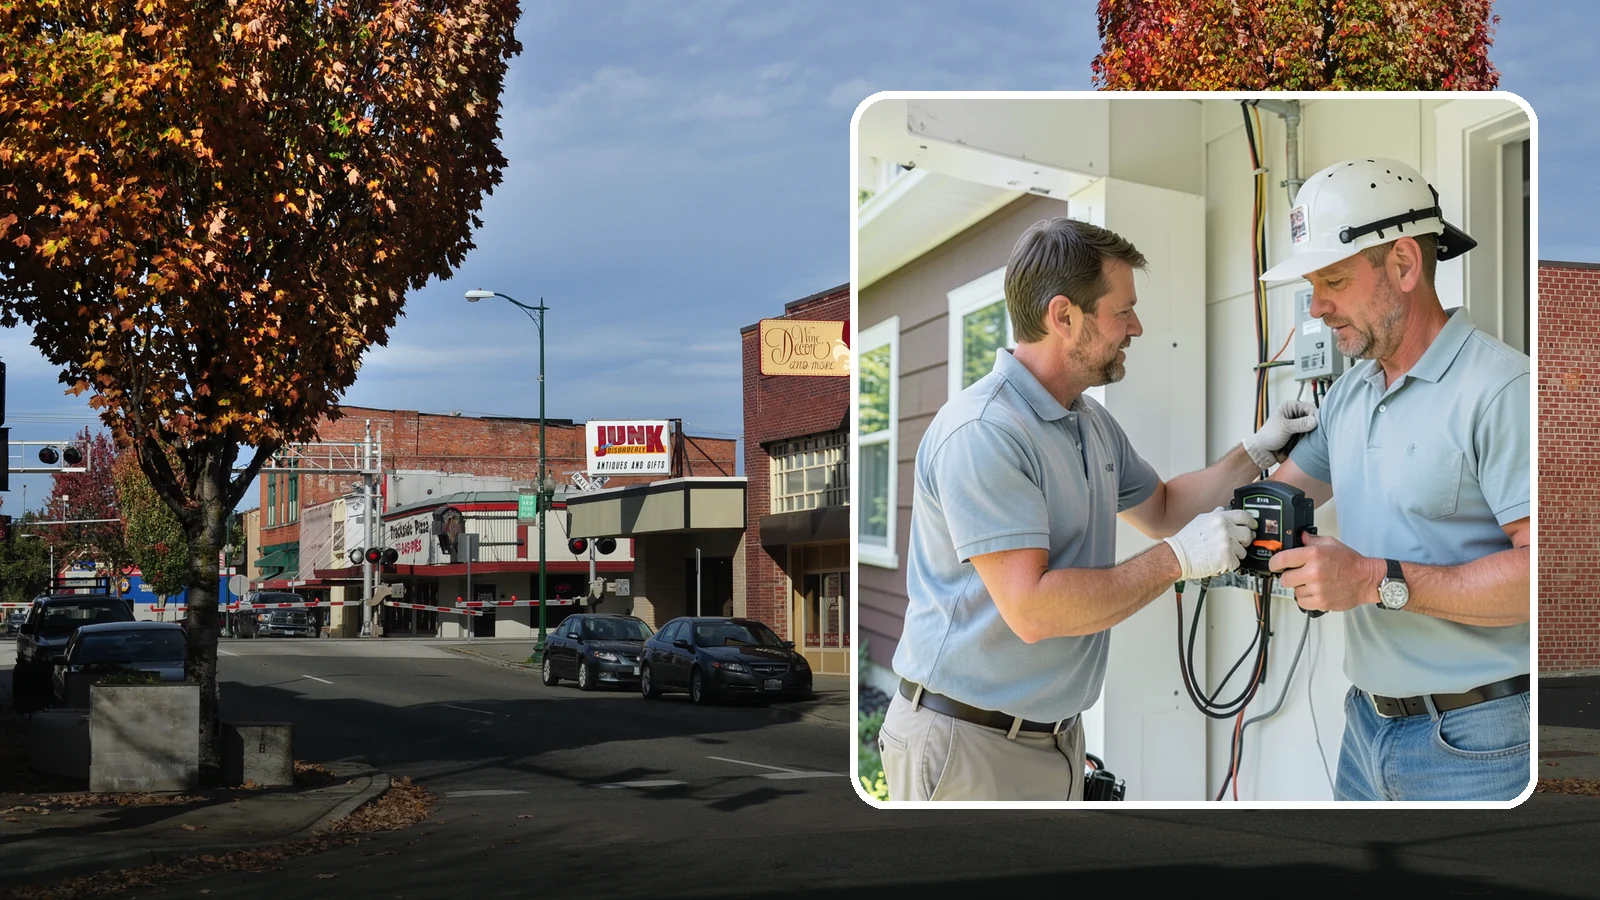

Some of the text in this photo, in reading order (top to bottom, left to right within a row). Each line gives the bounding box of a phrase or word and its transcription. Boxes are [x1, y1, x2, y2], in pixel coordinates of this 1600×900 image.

[764, 327, 831, 365] Decor
[595, 425, 665, 457] JUNK
[597, 460, 666, 470] ANTIQUES AND GIFTS
[573, 473, 588, 491] RAIL
[390, 519, 429, 540] Trackside Pizza
